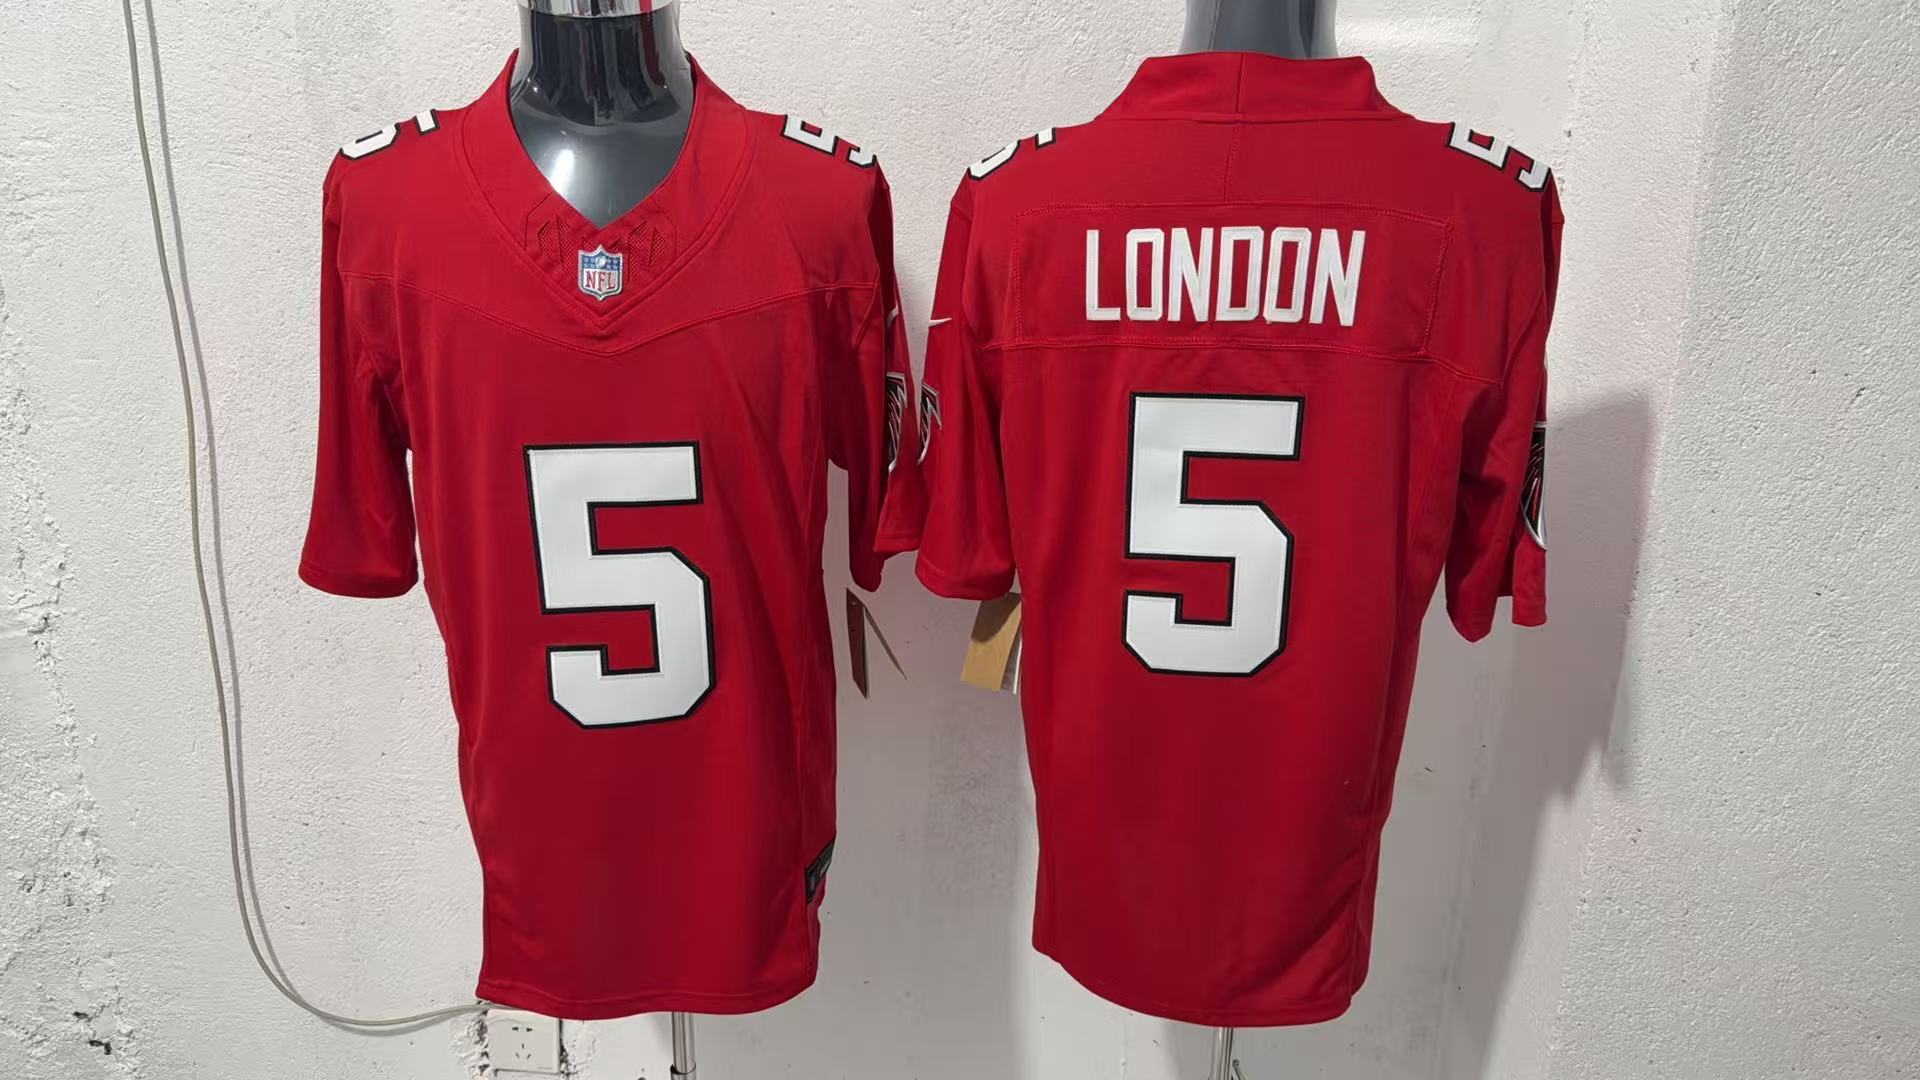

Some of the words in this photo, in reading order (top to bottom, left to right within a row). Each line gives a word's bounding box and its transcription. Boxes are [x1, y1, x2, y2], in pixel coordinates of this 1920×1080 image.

[585, 270, 616, 291] NFL
[1086, 226, 1366, 326] LONDON
[523, 441, 716, 729] 5
[1122, 392, 1305, 677] 5
